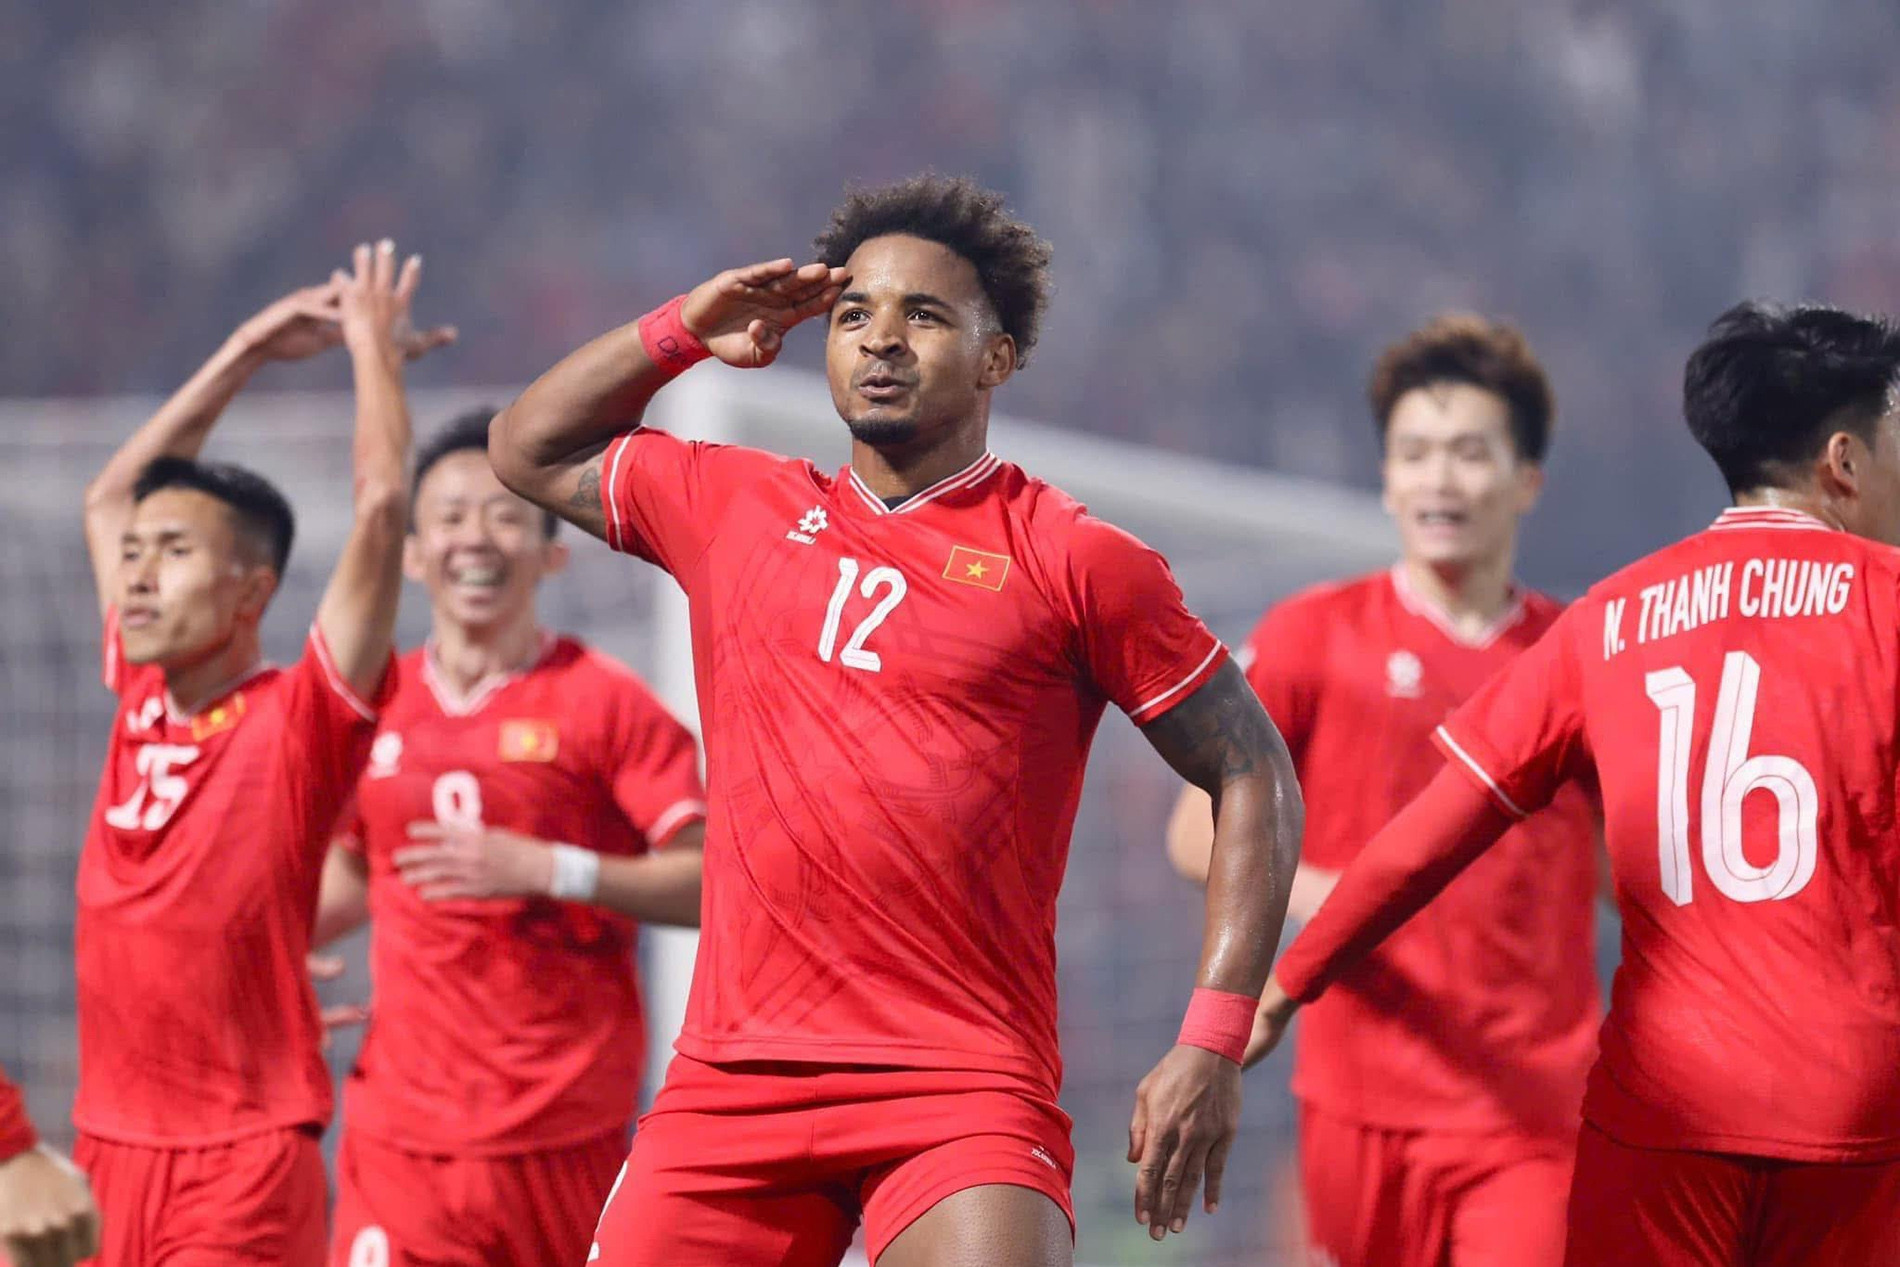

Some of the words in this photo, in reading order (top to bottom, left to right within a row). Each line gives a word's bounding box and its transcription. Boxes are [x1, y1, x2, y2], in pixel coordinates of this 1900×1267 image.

[817, 556, 908, 673] 12
[1603, 597, 1627, 661] N.
[1637, 561, 1734, 644] THANH
[1739, 557, 1855, 619] CHUNG
[1645, 650, 1819, 907] 16
